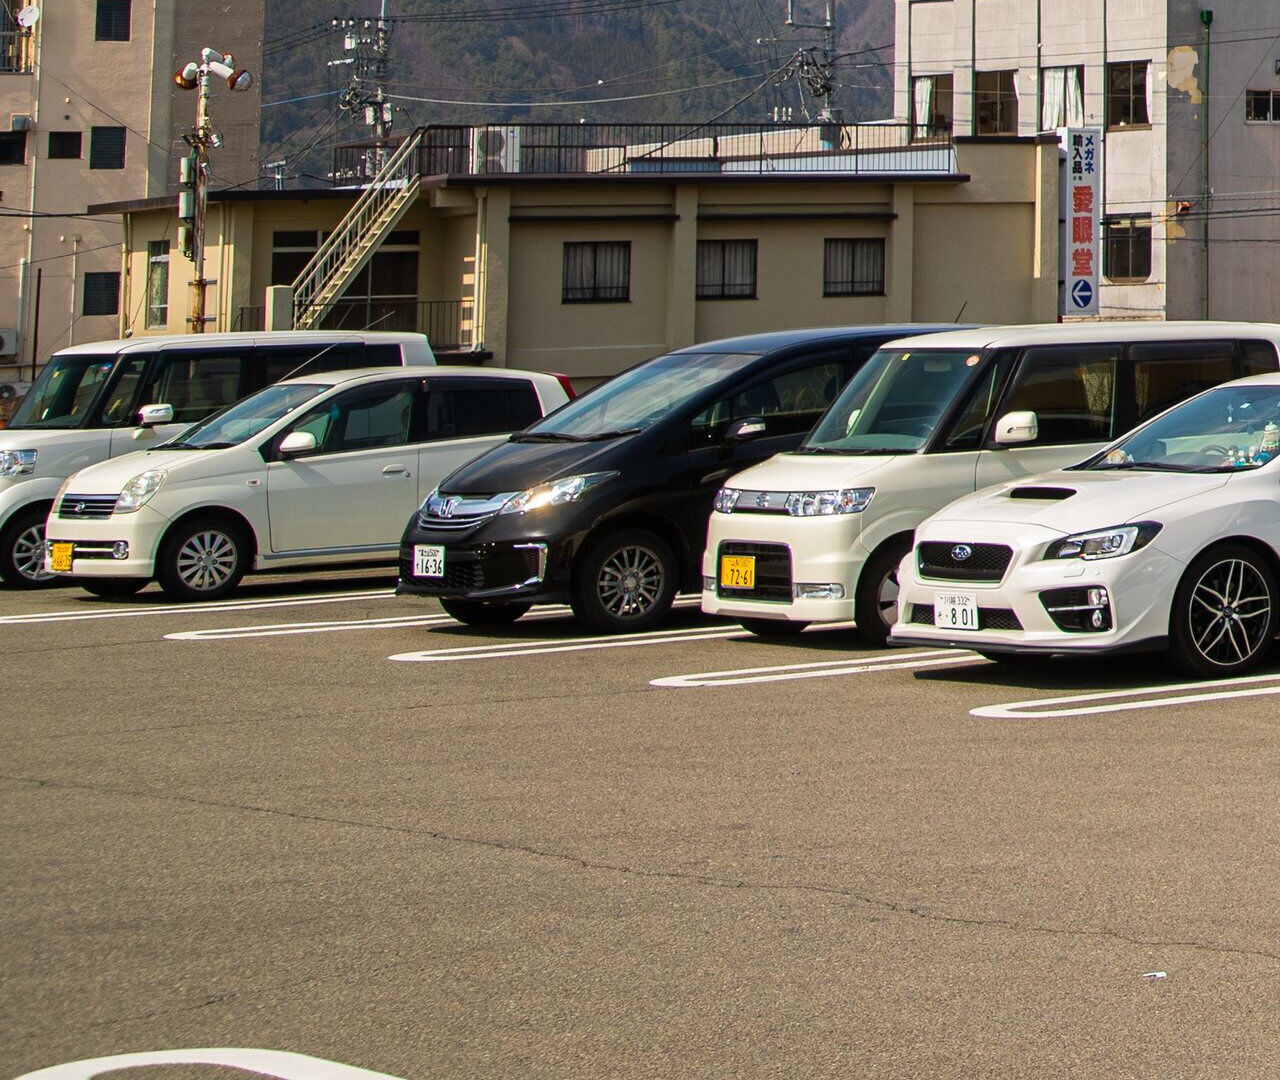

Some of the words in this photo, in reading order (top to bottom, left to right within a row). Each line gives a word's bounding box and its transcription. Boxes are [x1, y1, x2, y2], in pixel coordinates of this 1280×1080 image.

[1084, 134, 1095, 174] メガネ
[1072, 185, 1093, 277] 愛眼堂
[421, 558, 442, 574] 16-36
[730, 568, 752, 586] 72-61
